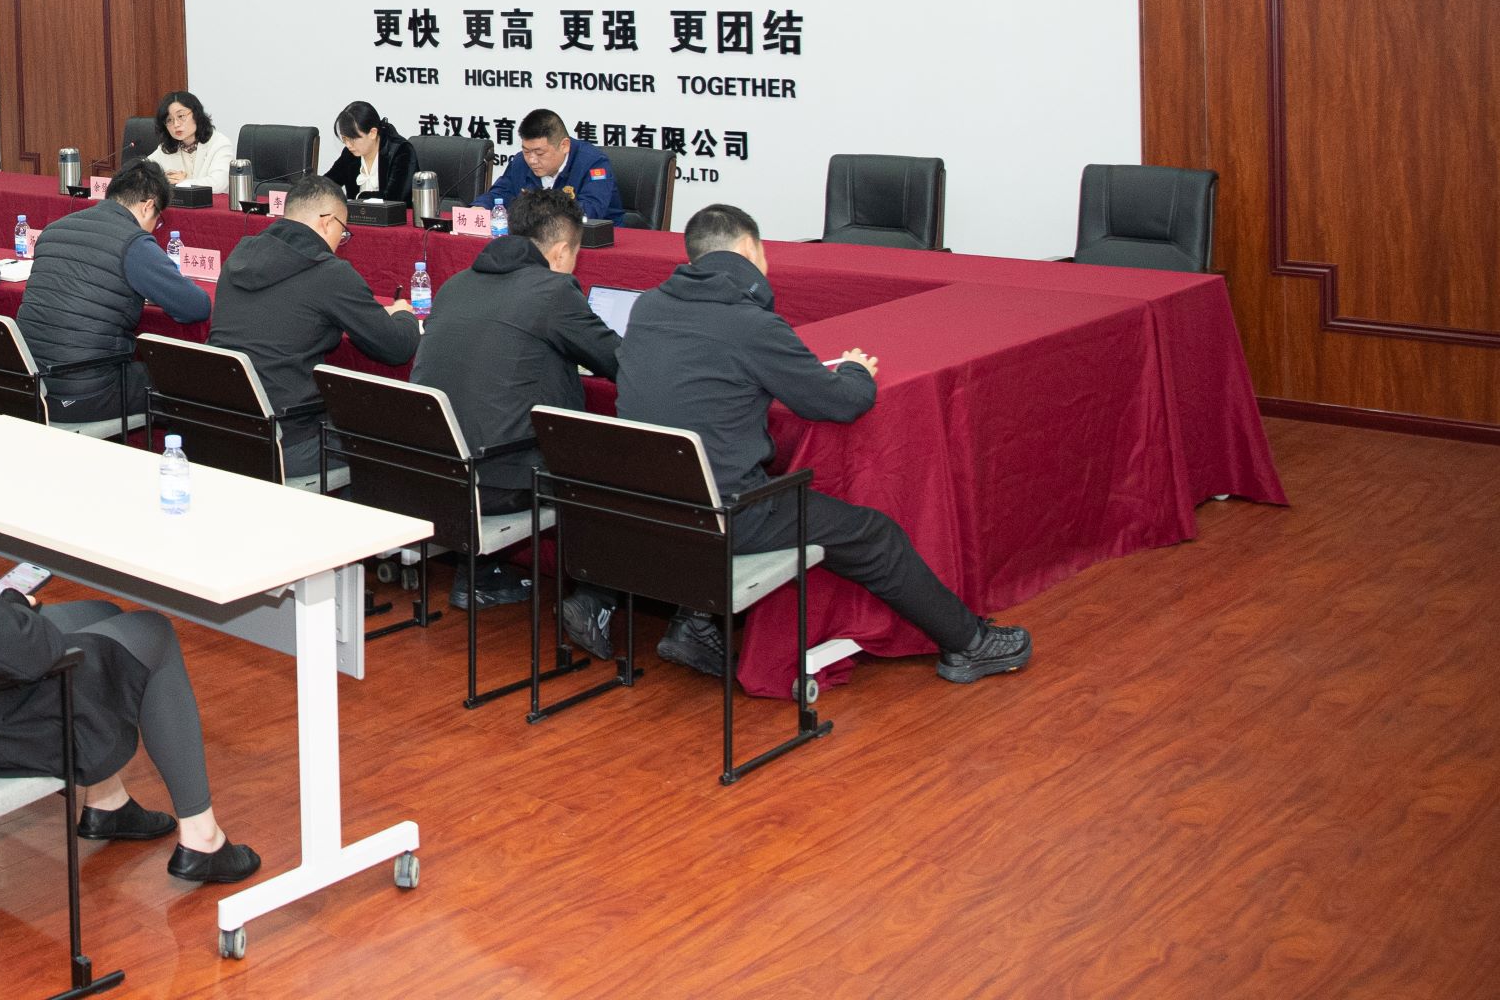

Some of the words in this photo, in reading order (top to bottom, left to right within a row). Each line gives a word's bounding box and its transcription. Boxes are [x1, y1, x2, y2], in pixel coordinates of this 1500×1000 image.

[373, 8, 440, 49] 更快
[462, 7, 534, 50] 更高
[559, 9, 640, 52] 更强
[669, 9, 804, 56] 更团结
[375, 66, 440, 85] FASTER
[464, 68, 533, 89] HIGHER
[545, 71, 656, 93] STRONGER
[677, 75, 797, 99] TOGETHER
[418, 113, 749, 161] 武汉体育集团有限公司
[456, 211, 487, 229] 杨航
